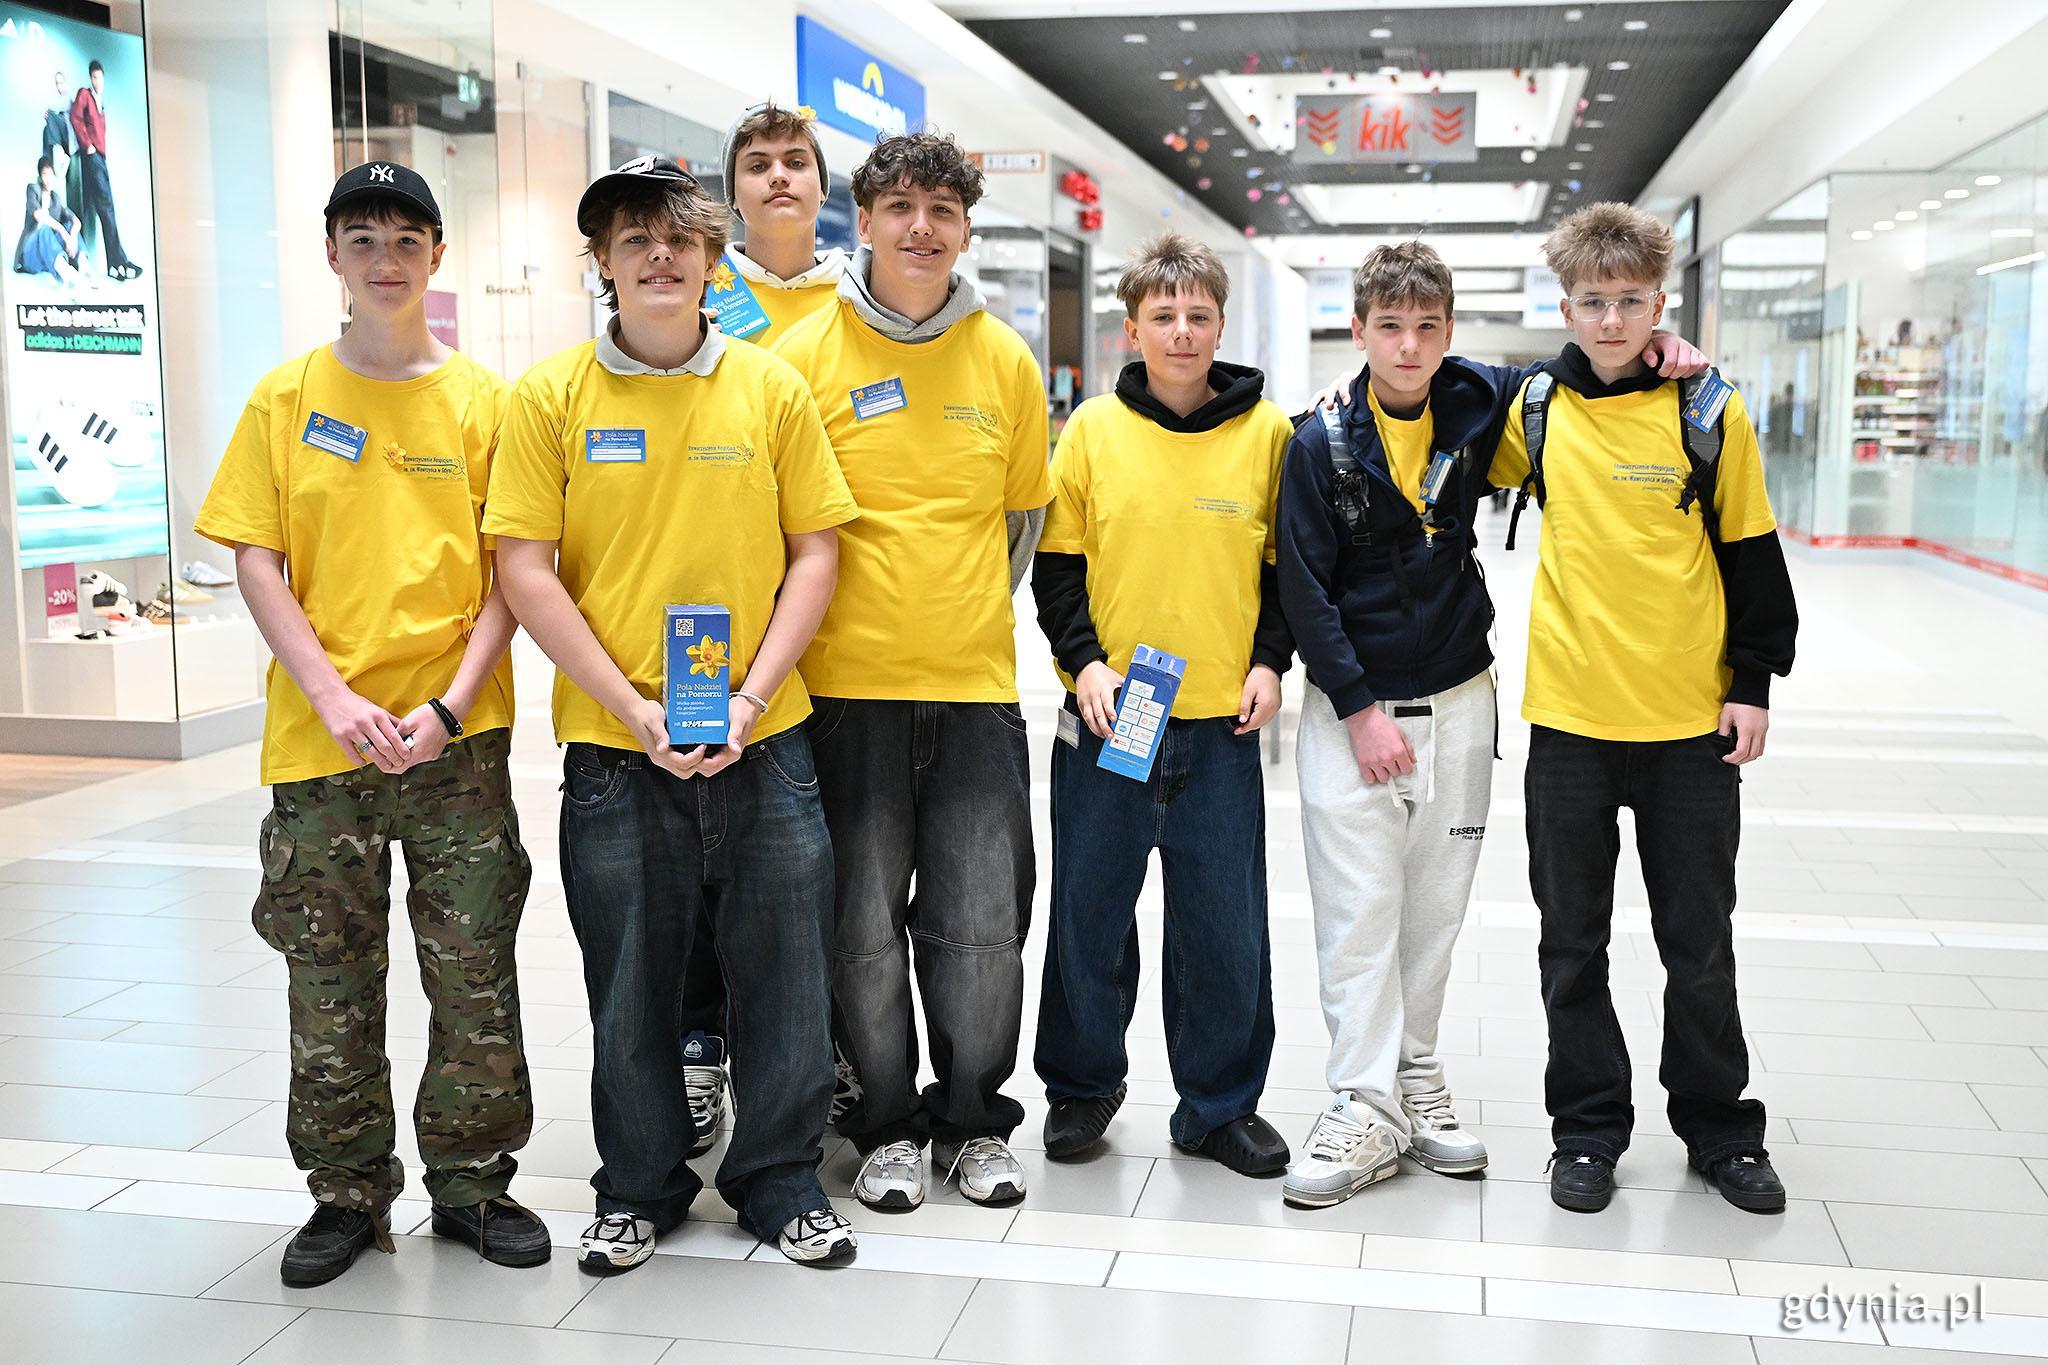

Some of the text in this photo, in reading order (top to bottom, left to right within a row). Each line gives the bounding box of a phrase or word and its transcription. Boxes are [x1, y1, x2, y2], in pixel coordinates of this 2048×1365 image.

[1359, 107, 1410, 151] kik
[370, 164, 395, 183] NY
[26, 331, 65, 349] adidas
[73, 335, 141, 352] DEICHMANN
[48, 588, 77, 606] -20%
[694, 683, 722, 691] Nadziei
